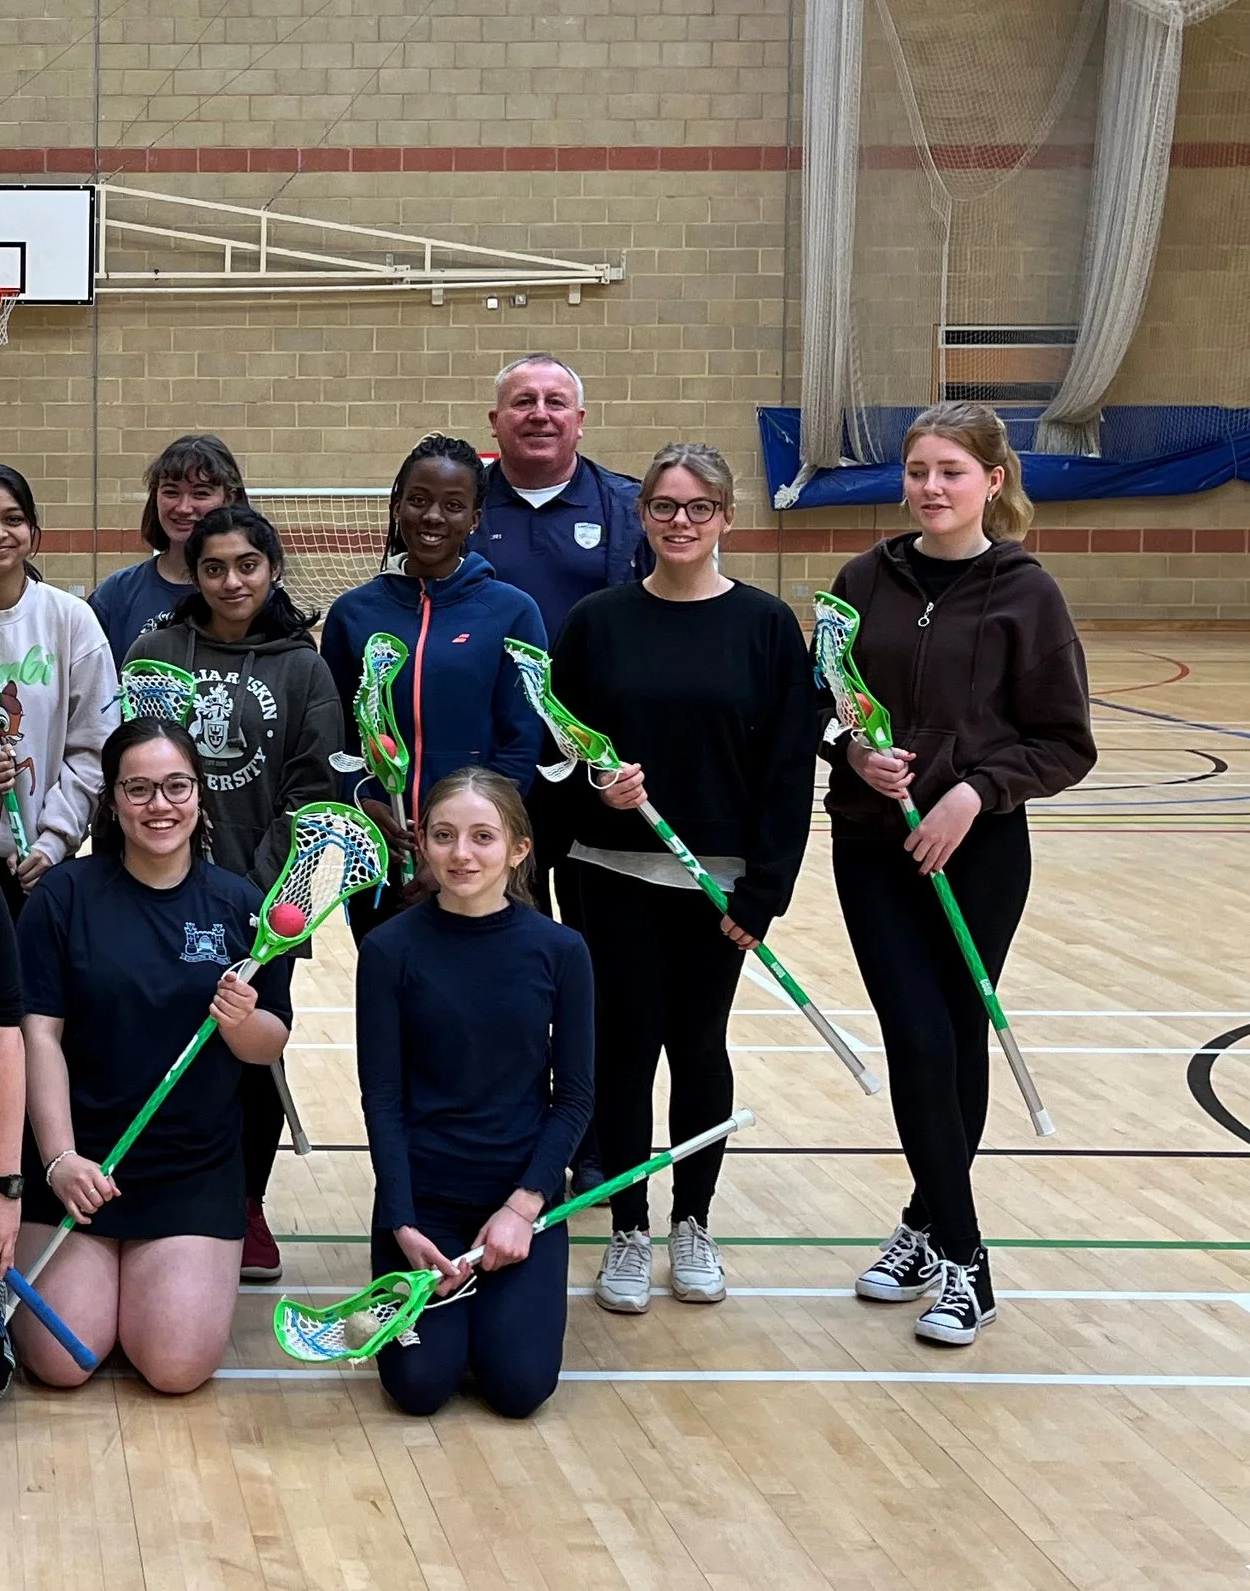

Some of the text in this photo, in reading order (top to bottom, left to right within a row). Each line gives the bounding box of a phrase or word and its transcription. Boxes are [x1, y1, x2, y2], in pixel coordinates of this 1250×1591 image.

[224, 672, 278, 720] RSKIN
[204, 746, 266, 791] ERSITY
[663, 834, 709, 881] STX
